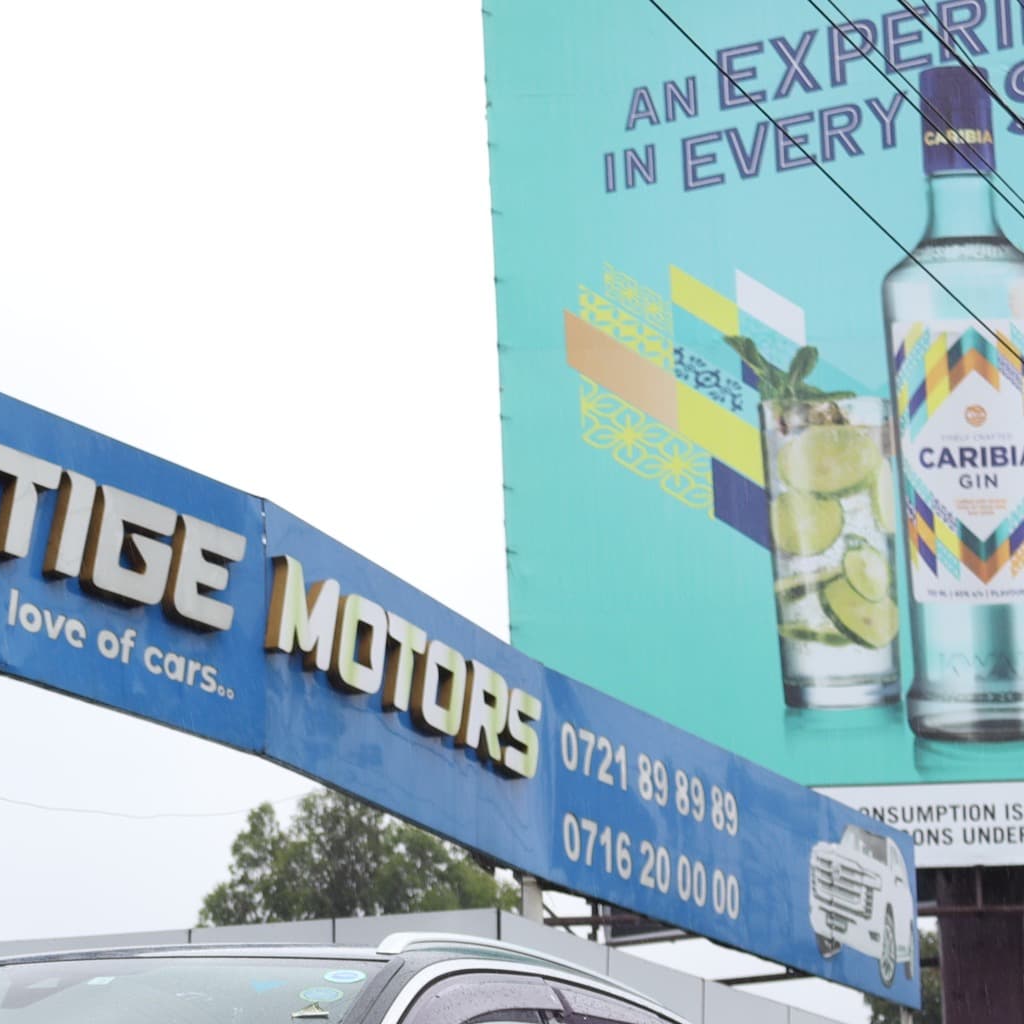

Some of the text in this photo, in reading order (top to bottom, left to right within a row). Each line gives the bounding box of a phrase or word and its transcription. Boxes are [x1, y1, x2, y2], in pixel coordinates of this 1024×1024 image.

[625, 75, 698, 131] AN
[716, 0, 1024, 111] EXPERI
[604, 92, 908, 193] IN EVERY
[924, 128, 993, 147] CARIBIA
[919, 445, 1024, 469] CARIBI
[959, 474, 998, 489] GIN
[8, 588, 87, 648] love
[97, 628, 136, 664] of
[265, 554, 543, 780] MOTORS
[561, 721, 739, 837] 0721 89 89 89
[1004, 803, 1024, 821] IS
[563, 812, 740, 920] 0716 20 00 00
[902, 827, 954, 846] ONS
